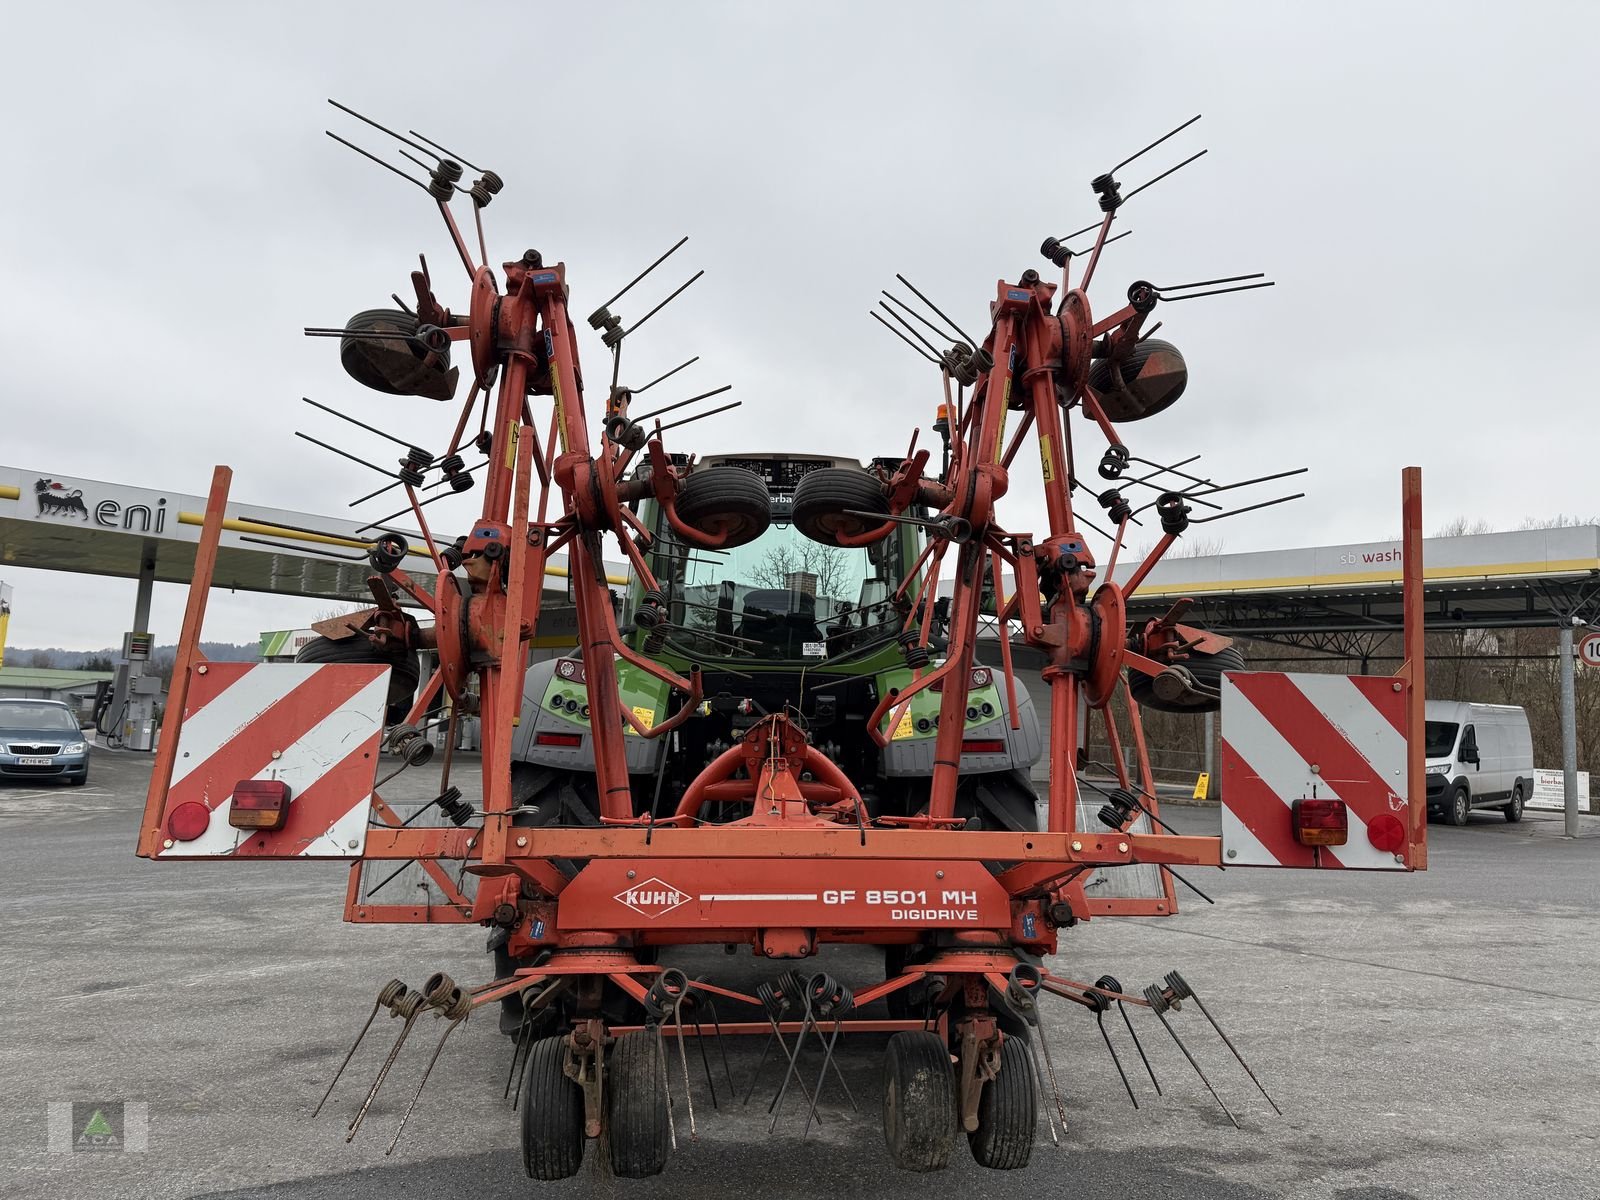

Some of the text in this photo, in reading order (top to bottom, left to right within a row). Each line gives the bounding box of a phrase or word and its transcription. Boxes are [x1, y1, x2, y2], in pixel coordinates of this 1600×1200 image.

[770, 492, 793, 503] erba
[96, 497, 167, 533] eni
[1340, 547, 1402, 565] sb wash
[626, 891, 680, 905] KUHN
[823, 890, 978, 905] GF 8501 MH
[891, 909, 979, 920] DIGIDRIVE
